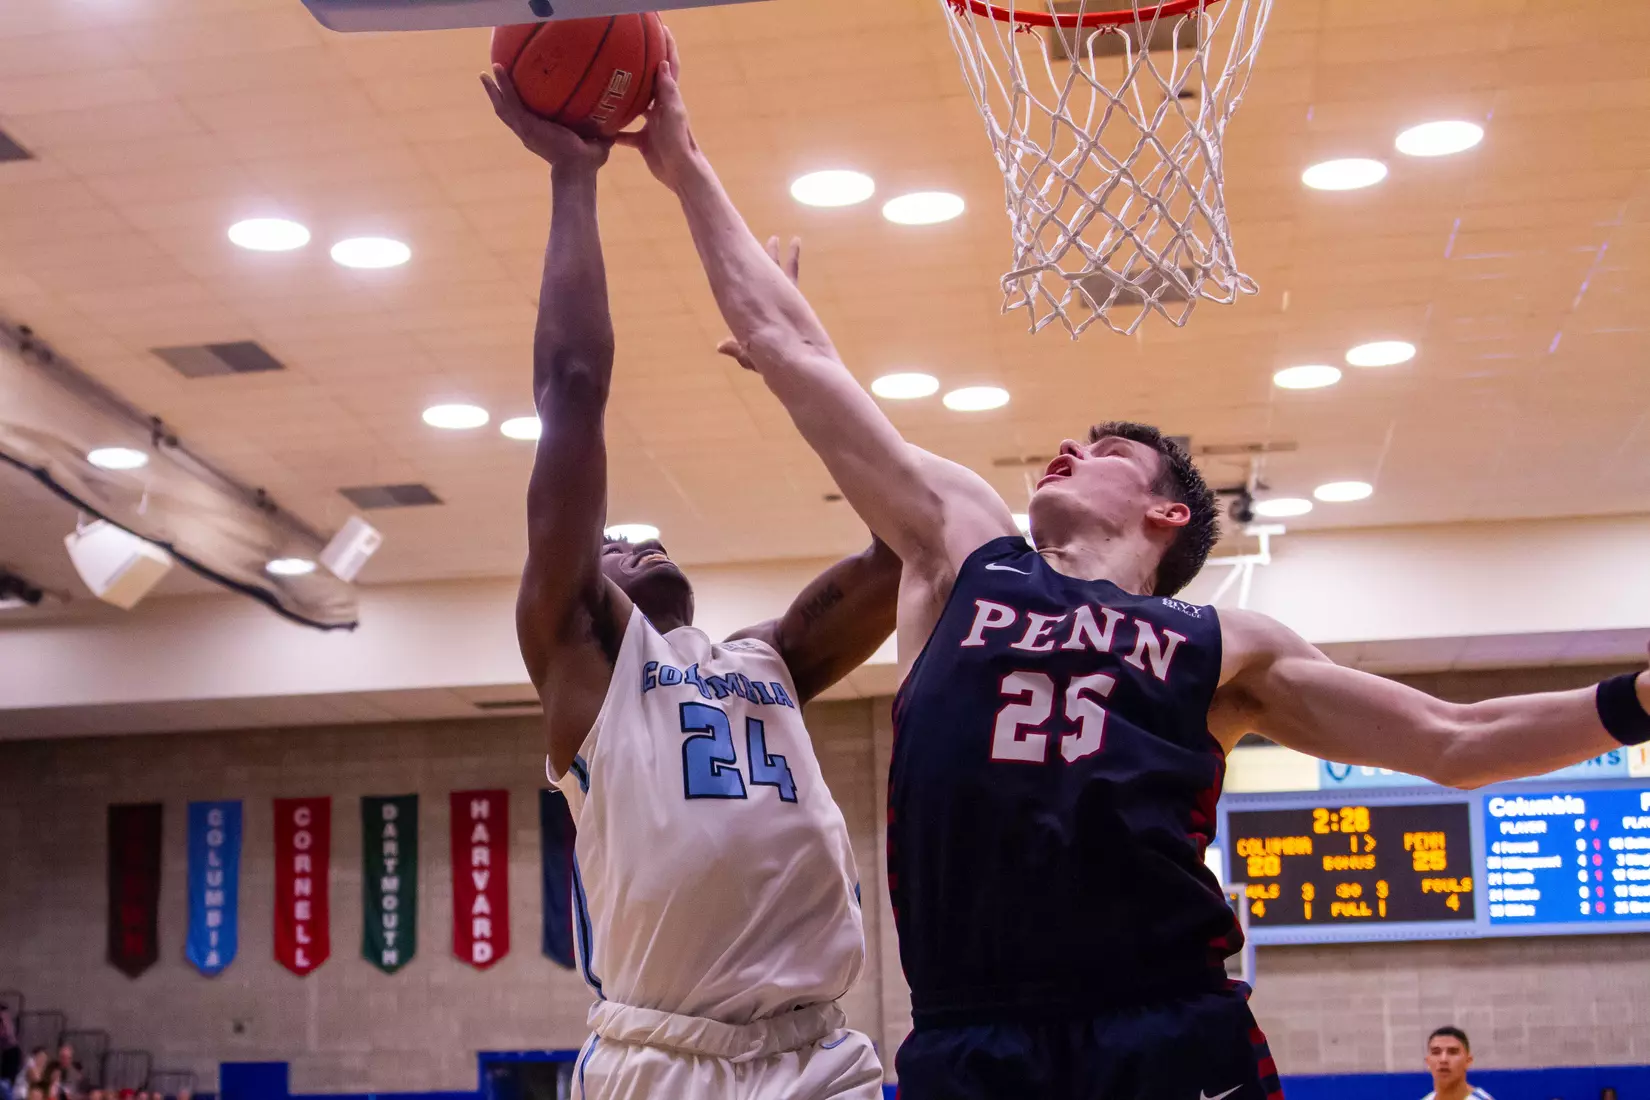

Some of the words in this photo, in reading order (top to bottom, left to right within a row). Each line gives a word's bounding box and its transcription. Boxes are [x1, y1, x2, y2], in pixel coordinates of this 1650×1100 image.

[960, 598, 1187, 681] PENN
[679, 701, 798, 804] 24
[989, 670, 1117, 765] 25
[1488, 794, 1586, 818] Columbia
[204, 808, 224, 967] COLUMBIA
[294, 806, 312, 967] CORNELL
[381, 803, 399, 966] DARTMOUTH
[470, 799, 493, 963] HARVARD
